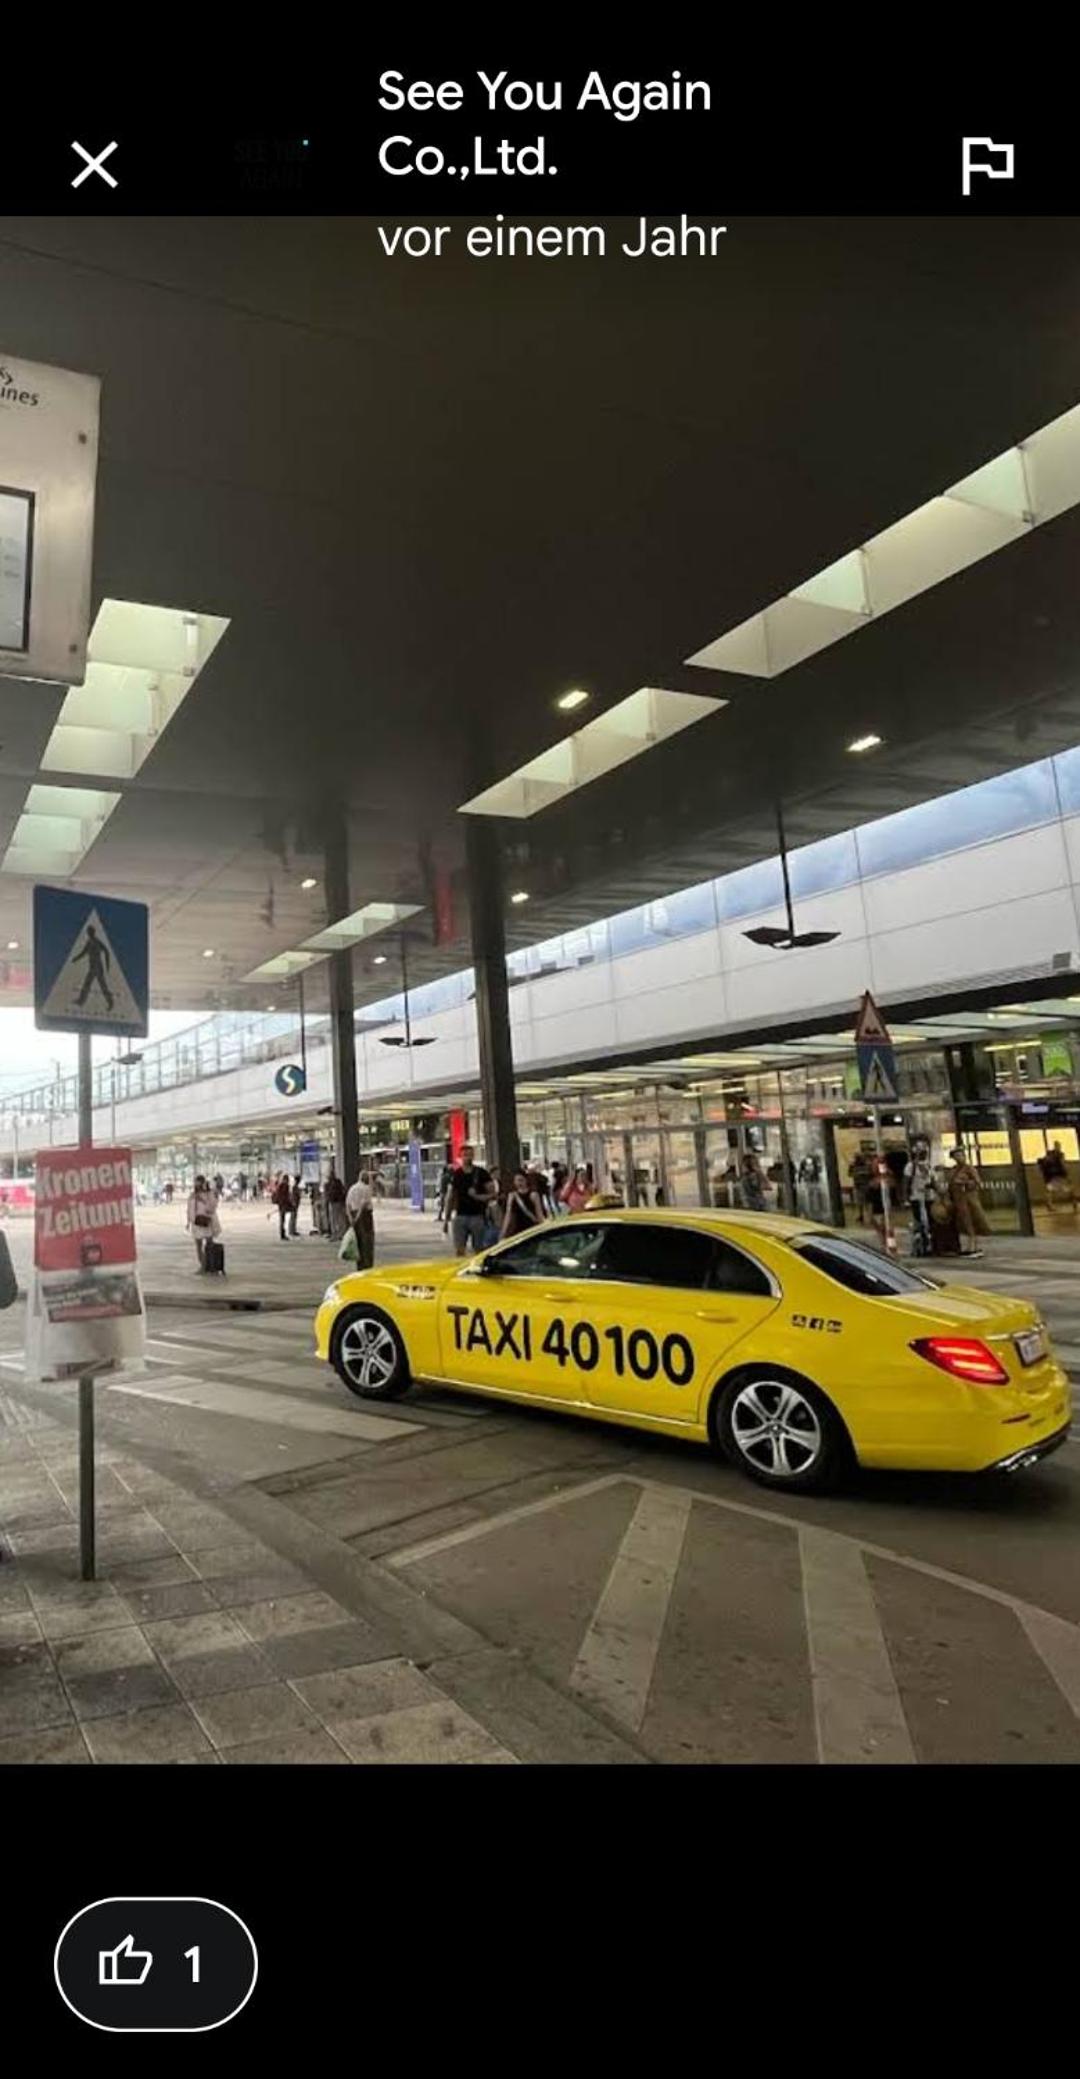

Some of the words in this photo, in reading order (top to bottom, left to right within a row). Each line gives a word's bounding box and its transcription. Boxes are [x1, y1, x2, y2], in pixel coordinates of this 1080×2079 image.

[36, 1160, 132, 1199] Kronen
[39, 1197, 134, 1238] Zeitung
[447, 1305, 532, 1361] TAXI
